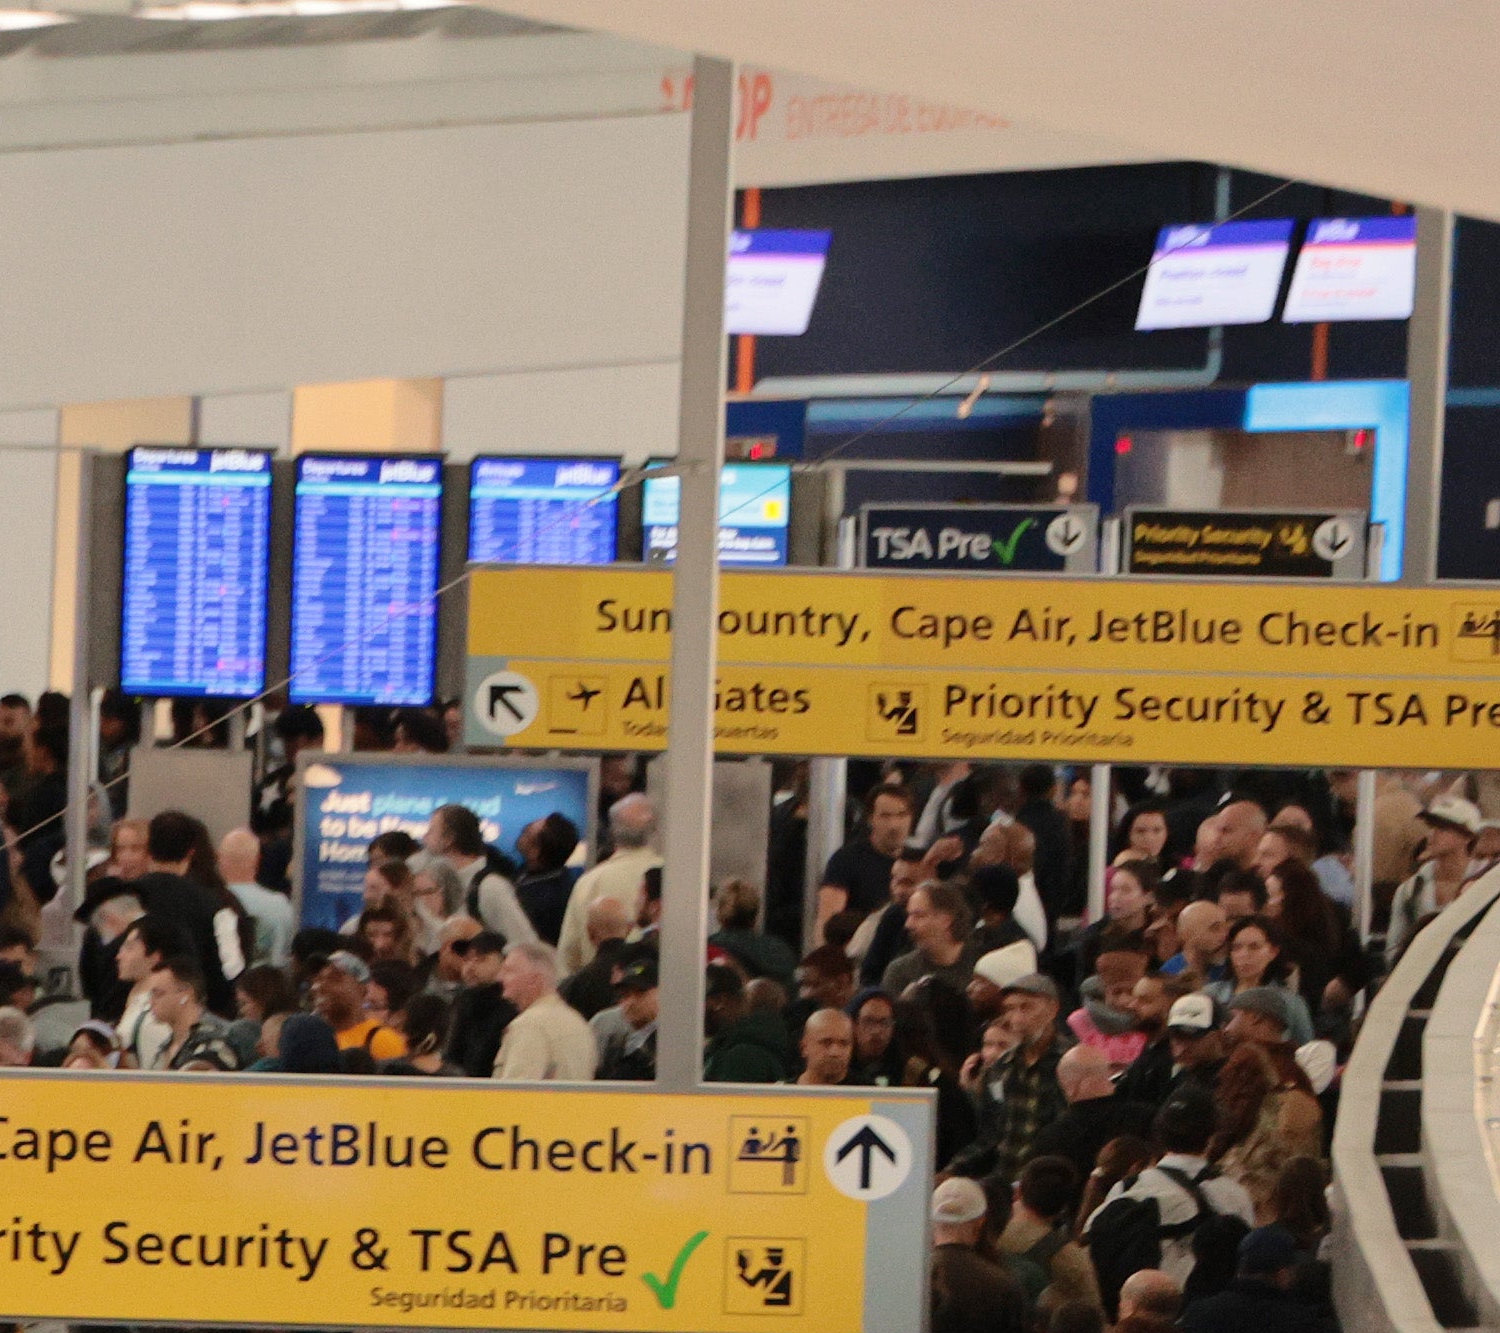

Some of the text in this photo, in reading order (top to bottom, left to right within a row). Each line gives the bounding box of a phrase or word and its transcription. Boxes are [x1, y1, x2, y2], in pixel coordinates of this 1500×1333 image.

[211, 448, 267, 472] jetBlue
[380, 459, 436, 485] jetBlue
[873, 528, 994, 560] TSA Pre
[598, 599, 1438, 648] Sun ountry, Cape Air, JetBlue Check-in
[945, 684, 1098, 729] Priority
[1115, 687, 1285, 733] Security
[1302, 691, 1330, 724] &
[1348, 692, 1427, 726] TSA
[941, 727, 1037, 751] Seguridad
[134, 1119, 222, 1170] Air,
[246, 1122, 449, 1169] JetBlue
[472, 1125, 711, 1174] Check-in
[104, 1221, 328, 1282] Security
[351, 1228, 388, 1271] &
[411, 1229, 518, 1273] TSA
[543, 1232, 626, 1277] Pre
[368, 1285, 629, 1313] Seguridad Prioritaria
